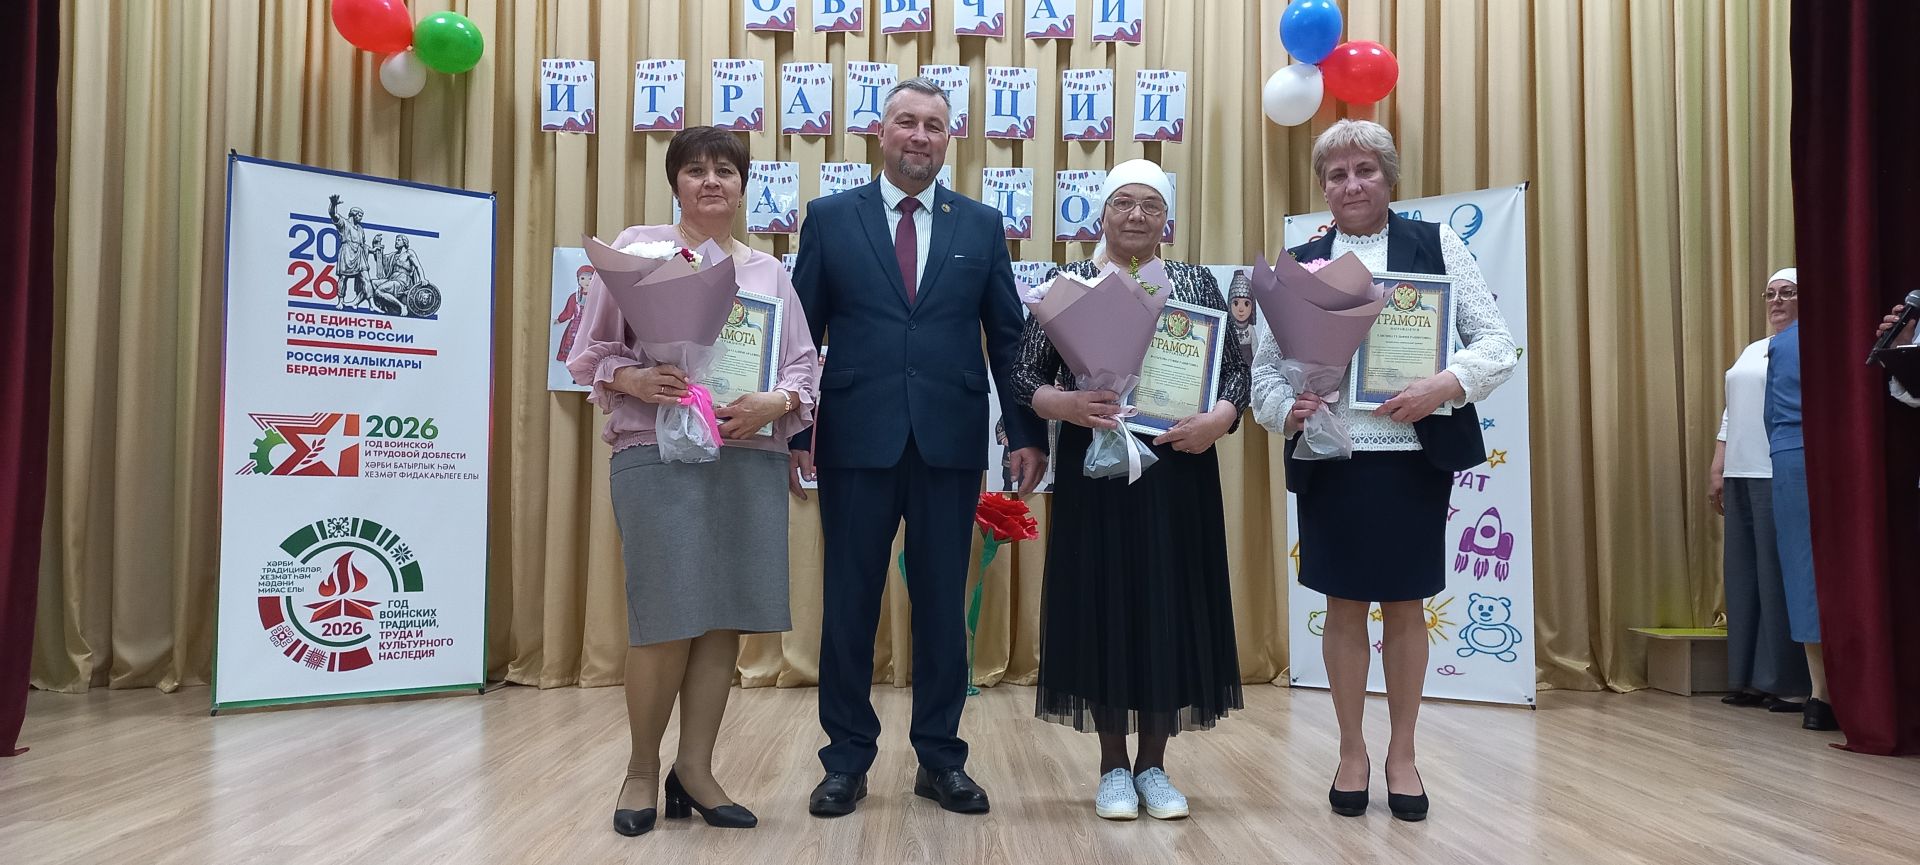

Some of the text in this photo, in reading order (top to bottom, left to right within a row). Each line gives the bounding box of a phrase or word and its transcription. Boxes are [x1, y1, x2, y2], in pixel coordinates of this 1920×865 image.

[288, 224, 341, 264] 20
[287, 261, 338, 300] 26
[287, 312, 392, 330] ГОД ЕДИНСТВА
[1377, 314, 1431, 328] ГРАМОТА
[287, 325, 414, 344] НАРОДОВ РОССИИ
[1151, 337, 1200, 358] ГРАМОТА
[287, 351, 421, 369] РОССИЯ ХАЛЫКЛАРЫ
[286, 364, 396, 380] БЕРДӘМЛЕГЕ ЕЛЫ
[366, 414, 438, 439] 2026
[365, 440, 433, 449] ГОД ВОИНСКОЙ
[374, 450, 420, 459] ТРУДОВОЙ
[422, 452, 466, 460] ДОБЛЕСТИ
[394, 462, 435, 470] БАТЫРЛЫК
[365, 471, 397, 479] ХЕЗМӘТ
[399, 472, 461, 480] ФИДАКАРЬЛЕГЕ
[388, 600, 408, 609] ГОД
[380, 608, 436, 618] ВОИНСКИХ
[321, 622, 362, 637] 2026
[379, 619, 439, 630] ТРАДИЦИЙ,
[379, 629, 423, 640] ТРУДА И
[379, 638, 453, 649] КУЛЬТУРНОГО
[379, 649, 435, 661] НАСЛЕДИЯ
